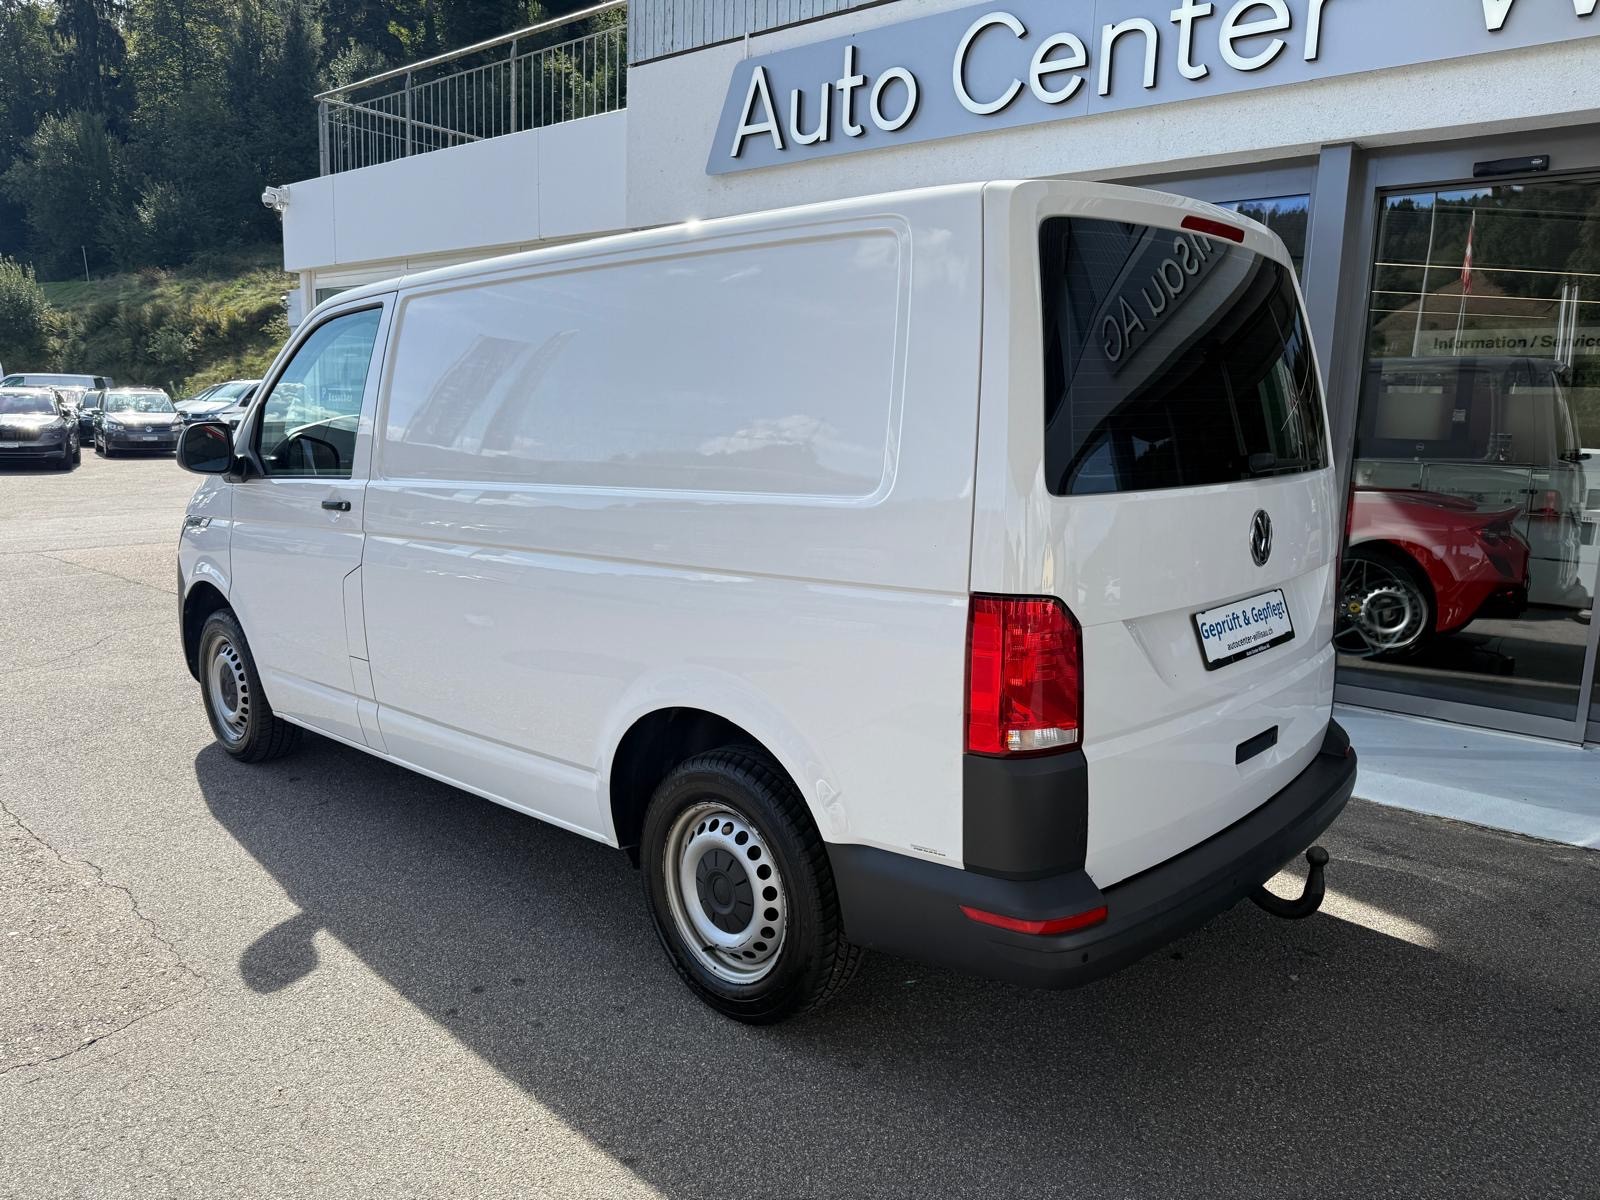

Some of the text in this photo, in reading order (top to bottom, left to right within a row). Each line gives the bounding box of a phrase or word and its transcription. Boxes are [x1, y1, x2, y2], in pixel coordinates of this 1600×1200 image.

[729, 0, 1330, 160] Auto Center
[1433, 335, 1527, 349] Information
[1200, 600, 1285, 640] Geprüft & Gepflegt
